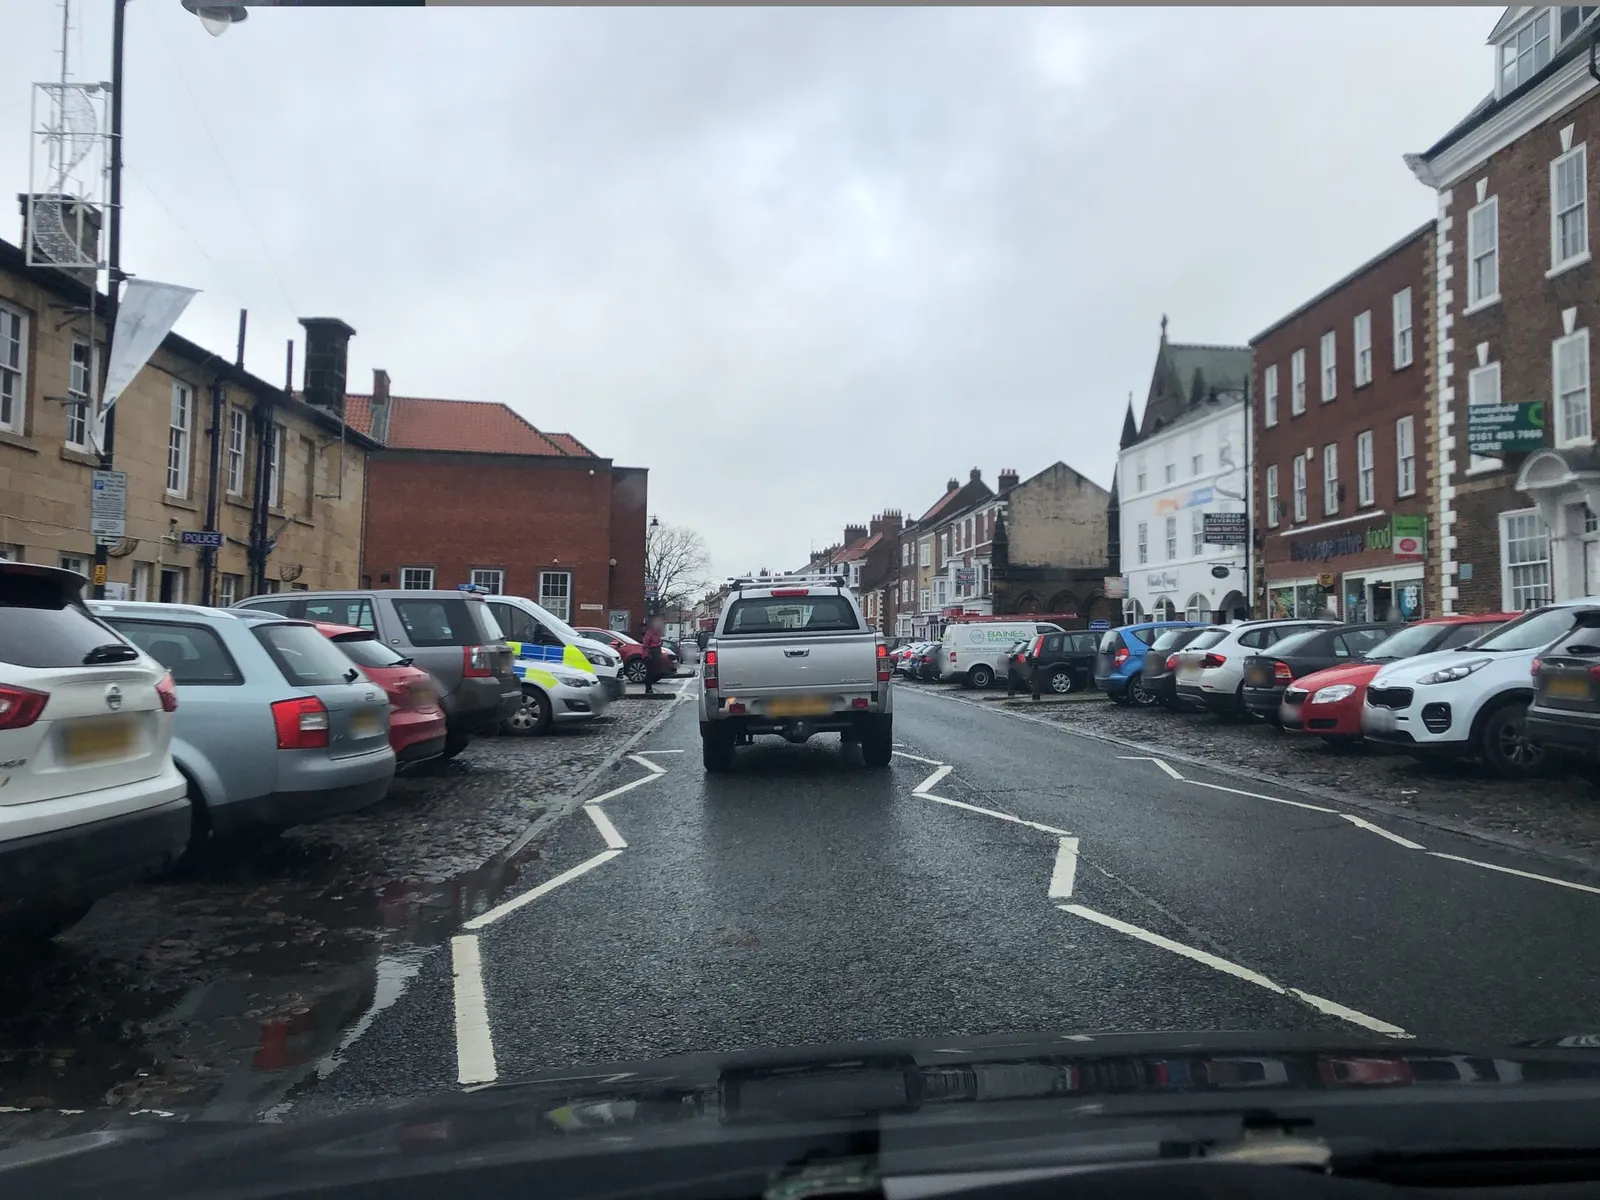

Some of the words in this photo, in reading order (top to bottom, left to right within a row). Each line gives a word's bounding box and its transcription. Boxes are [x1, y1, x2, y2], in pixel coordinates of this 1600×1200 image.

[1469, 403, 1519, 414] Leasehold
[1468, 432, 1493, 441] 0161
[1470, 442, 1502, 451] CBRE
[184, 533, 220, 544] POLICE
[1366, 522, 1391, 550] food
